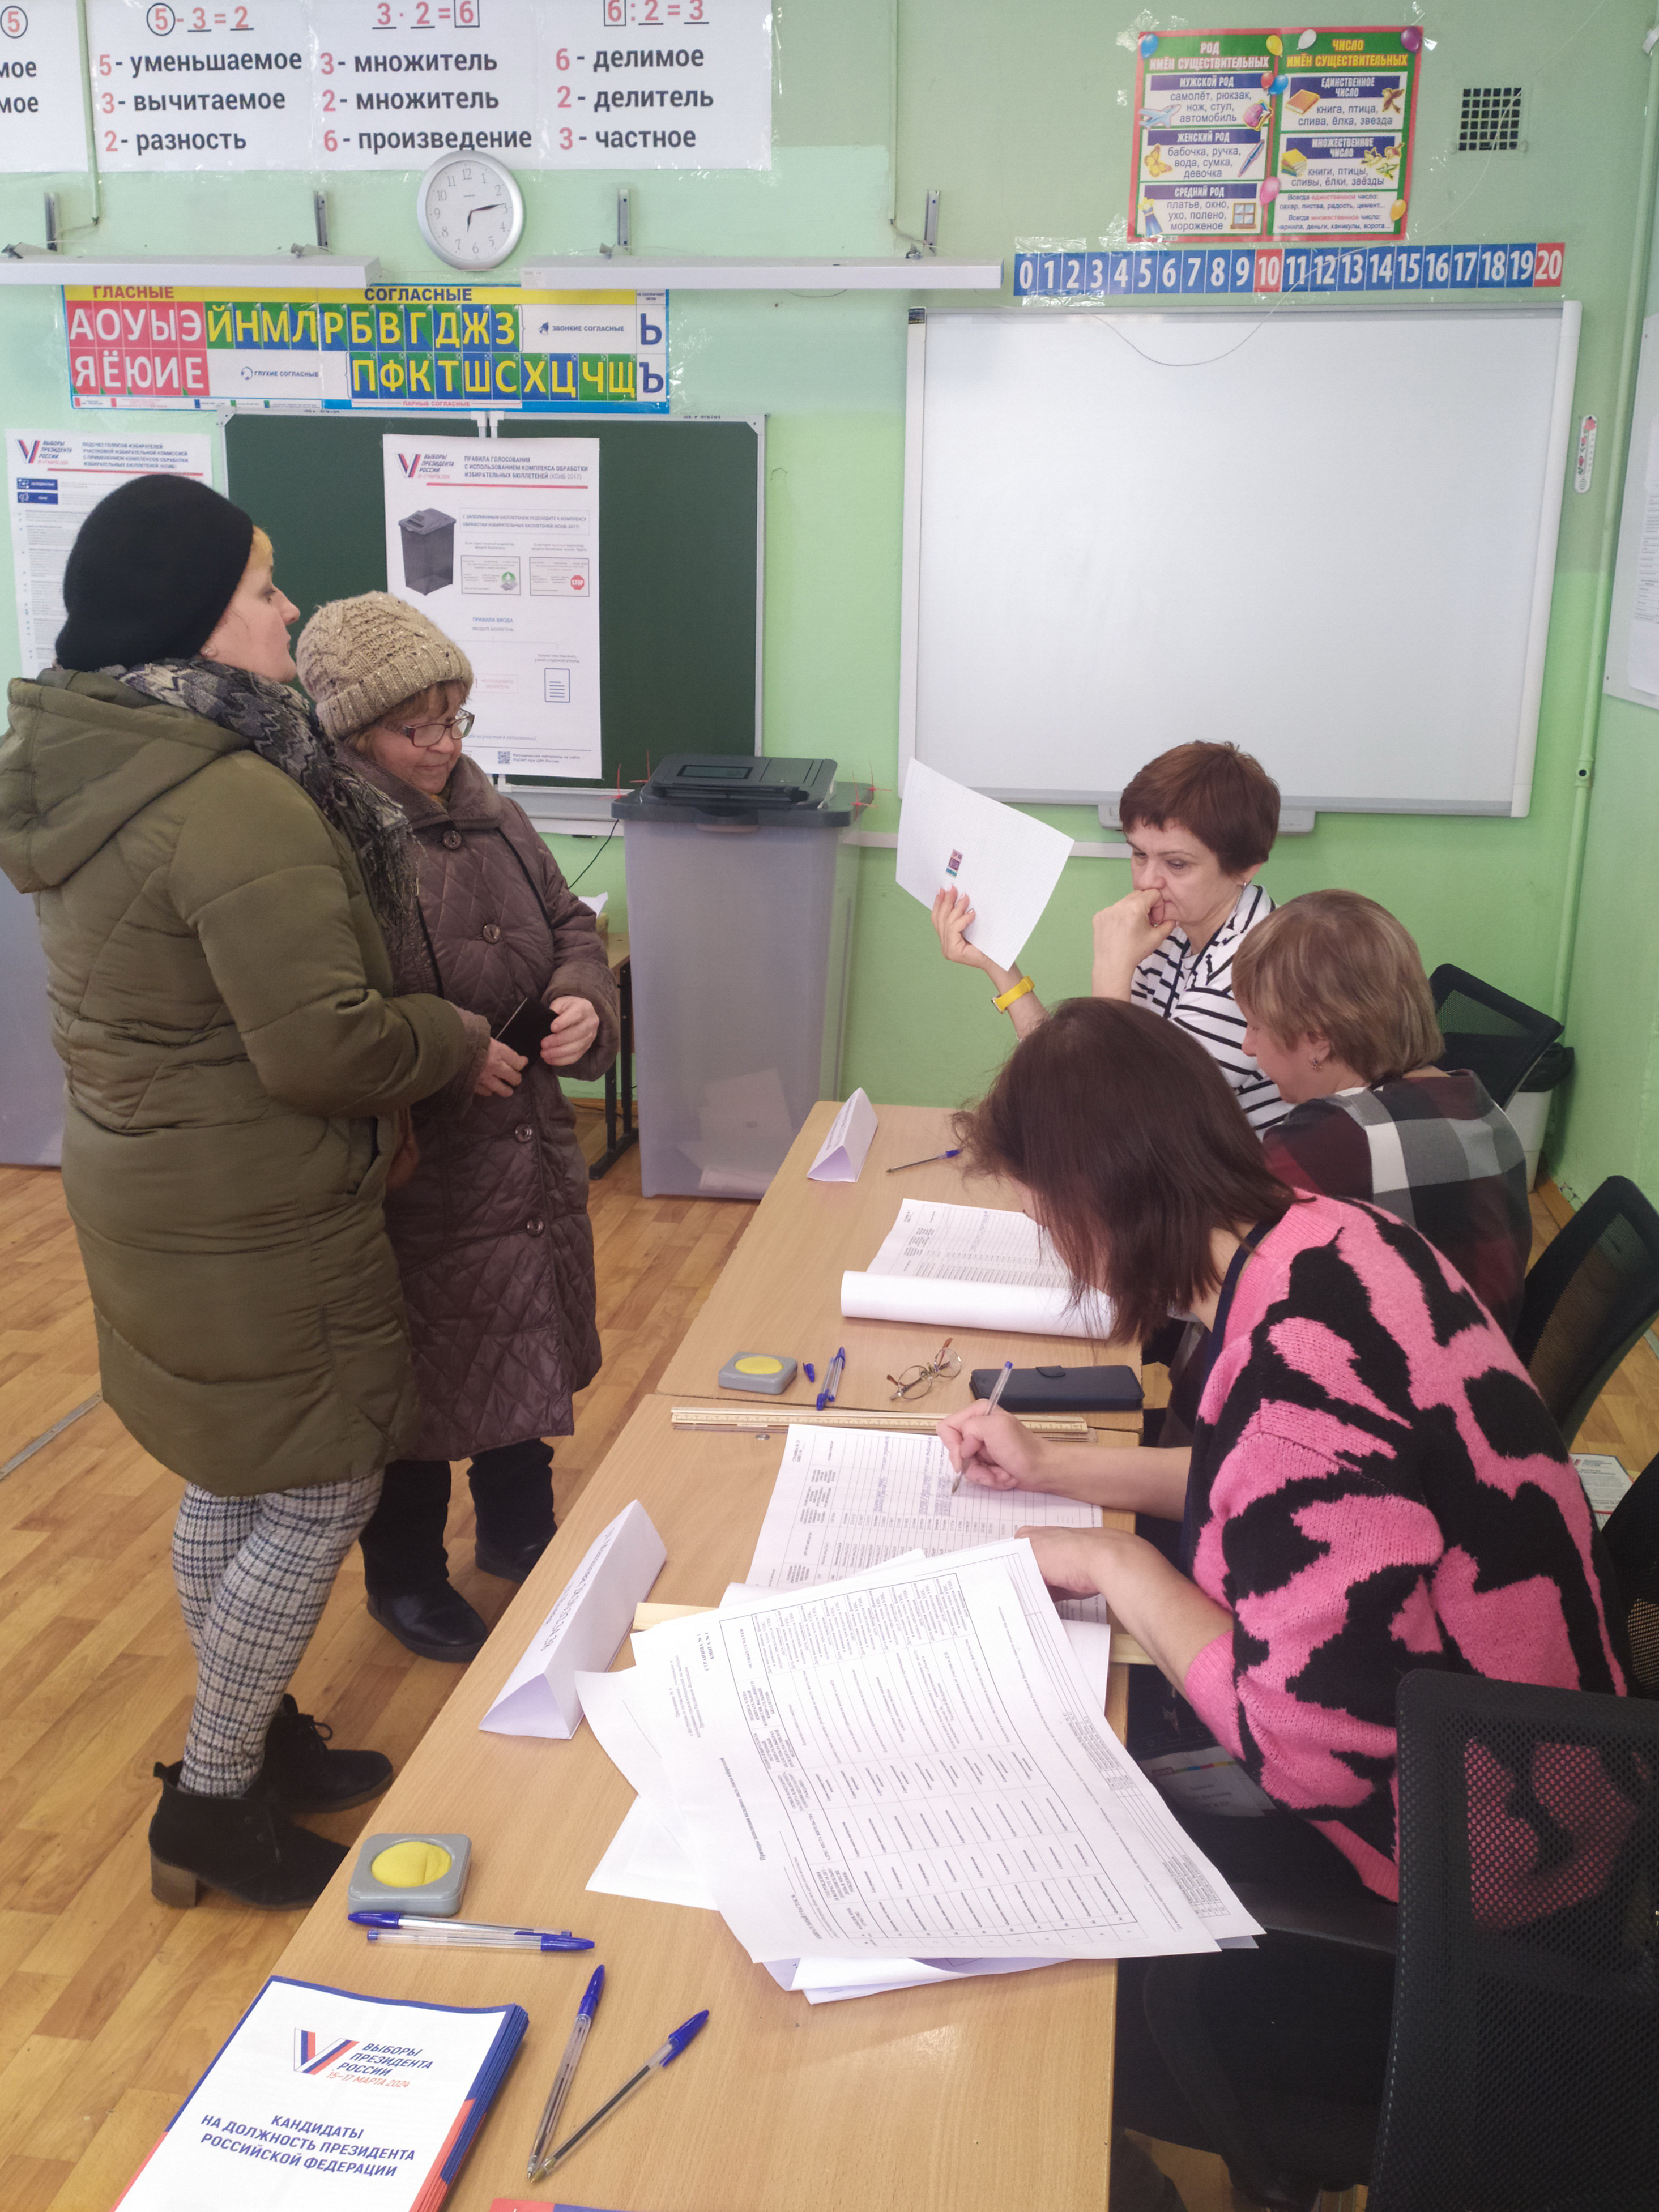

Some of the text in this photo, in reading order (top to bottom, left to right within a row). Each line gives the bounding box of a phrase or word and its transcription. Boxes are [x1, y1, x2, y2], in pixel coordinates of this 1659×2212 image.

[1200, 41, 1219, 55] РОД
[1332, 39, 1364, 52] ЧИСЛО
[131, 53, 302, 78] уменьшаемое
[354, 53, 497, 73] множитель
[593, 48, 704, 72] делимое
[1149, 57, 1269, 71] ИМЁН СУЩЕСТВИТЕЛЬНЫХ
[1287, 54, 1408, 67] ИМЁН СУЩЕСТВИТЕЛЬНЫХ
[1180, 76, 1234, 88] МУЖСКОЙ РОД
[1321, 78, 1375, 88] ЕДИНСТВЕННОЕ
[1216, 91, 1252, 102] рюкзак,
[1336, 88, 1359, 99] ЧИСЛО
[134, 93, 285, 112] вычитаемое
[356, 90, 499, 110] множитель
[594, 88, 714, 113] делитель
[1186, 103, 1234, 113] нож, стул,
[1317, 105, 1378, 115] книга, птица,
[1180, 113, 1237, 123] автомобиль
[1298, 117, 1328, 126] слива,
[1360, 117, 1392, 126] звезда
[359, 128, 532, 154] произведение
[595, 129, 696, 149] частное
[1178, 131, 1230, 143] ЖЕНСКИЙ РОД
[1312, 137, 1374, 148] МНОЖЕСТВЕННОЕ
[136, 133, 246, 156] разность
[1168, 147, 1241, 158] бабочка, ручка,
[1330, 148, 1354, 158] ЧИСЛО
[1174, 158, 1232, 169] вода, сумка,
[462, 168, 472, 180] 12
[482, 173, 486, 183] 1
[1183, 169, 1222, 180] девочка
[447, 176, 455, 187] 11
[1351, 177, 1384, 187] звёзды
[438, 190, 447, 201] 10
[495, 185, 501, 196] 2
[1175, 186, 1225, 198] СРЕДНИЙ РОД
[434, 208, 440, 219] 9
[442, 226, 448, 237] 8
[500, 222, 505, 232] 4
[1170, 222, 1223, 231] мороженое
[455, 239, 461, 250] 7
[488, 236, 494, 247] 5
[472, 243, 479, 254] 6
[1020, 250, 1562, 289] 0 1 2 3 4 5 6 7 8 9 10 11 12 13 14 15 16 17 18 19 20
[93, 287, 174, 300] ГЛАСНЫЕ
[364, 288, 472, 301] СОГЛАСНЫЕ
[362, 2043, 423, 2056] ВЫБОРЫ
[349, 2053, 433, 2069] ПРЕЗИДЕНТА
[337, 2062, 393, 2076] РОССИИ
[355, 2076, 386, 2086] МАРТА
[386, 2079, 411, 2088] 2024
[271, 2115, 364, 2140] КАНДИДАТЫ
[201, 2115, 415, 2160] НА ДОЛЖНОСТЬ ПРЕЗИДЕНТА
[201, 2133, 398, 2177] РОССИЙСКОЙ ФЕДЕРАЦИИ
